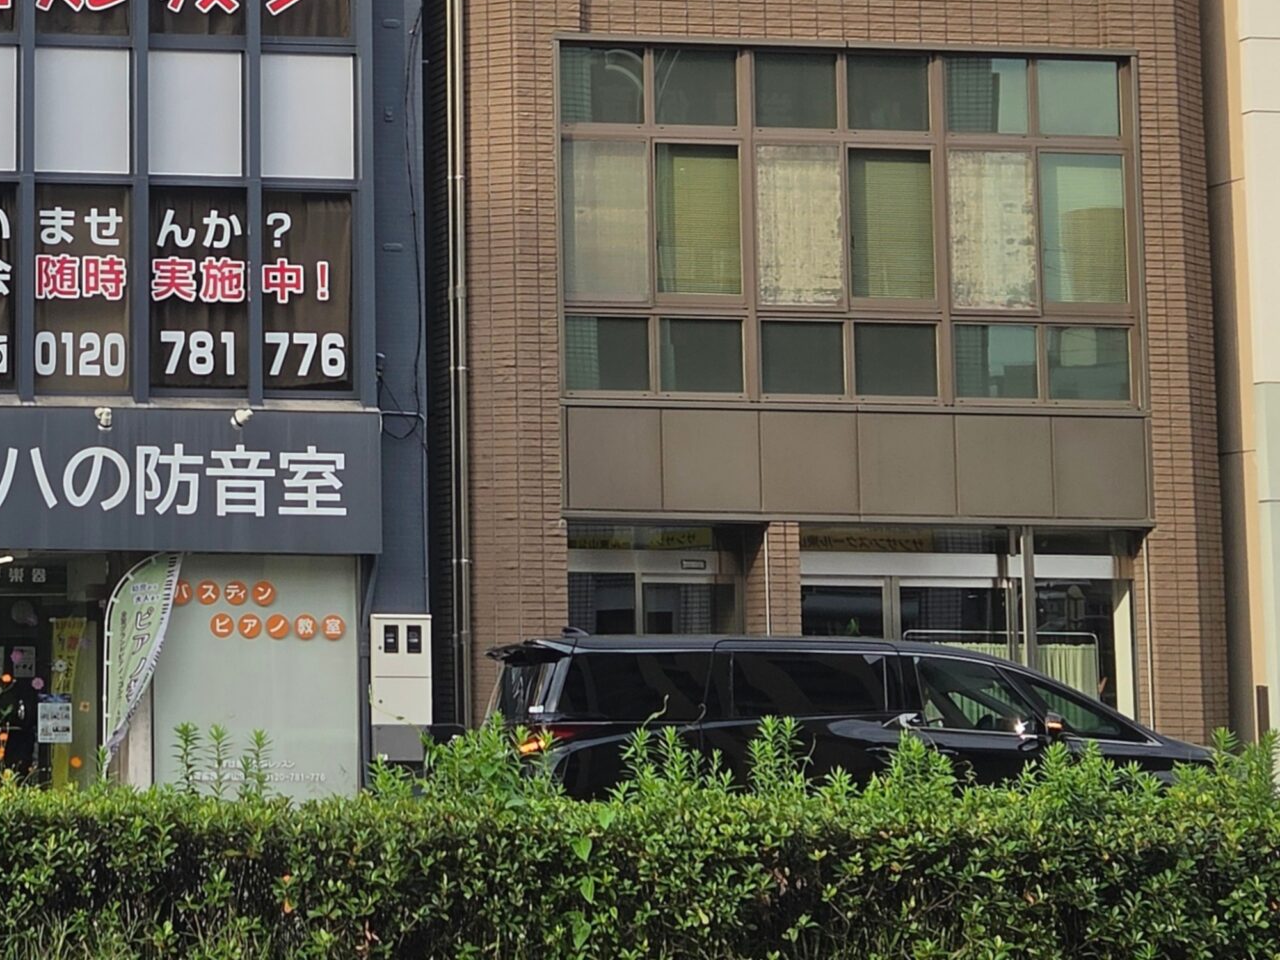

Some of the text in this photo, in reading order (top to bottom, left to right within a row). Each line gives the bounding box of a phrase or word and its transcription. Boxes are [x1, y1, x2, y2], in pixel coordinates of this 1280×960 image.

[34, 329, 346, 378] 0120 781 776
[214, 617, 342, 635] ピアノ教室
